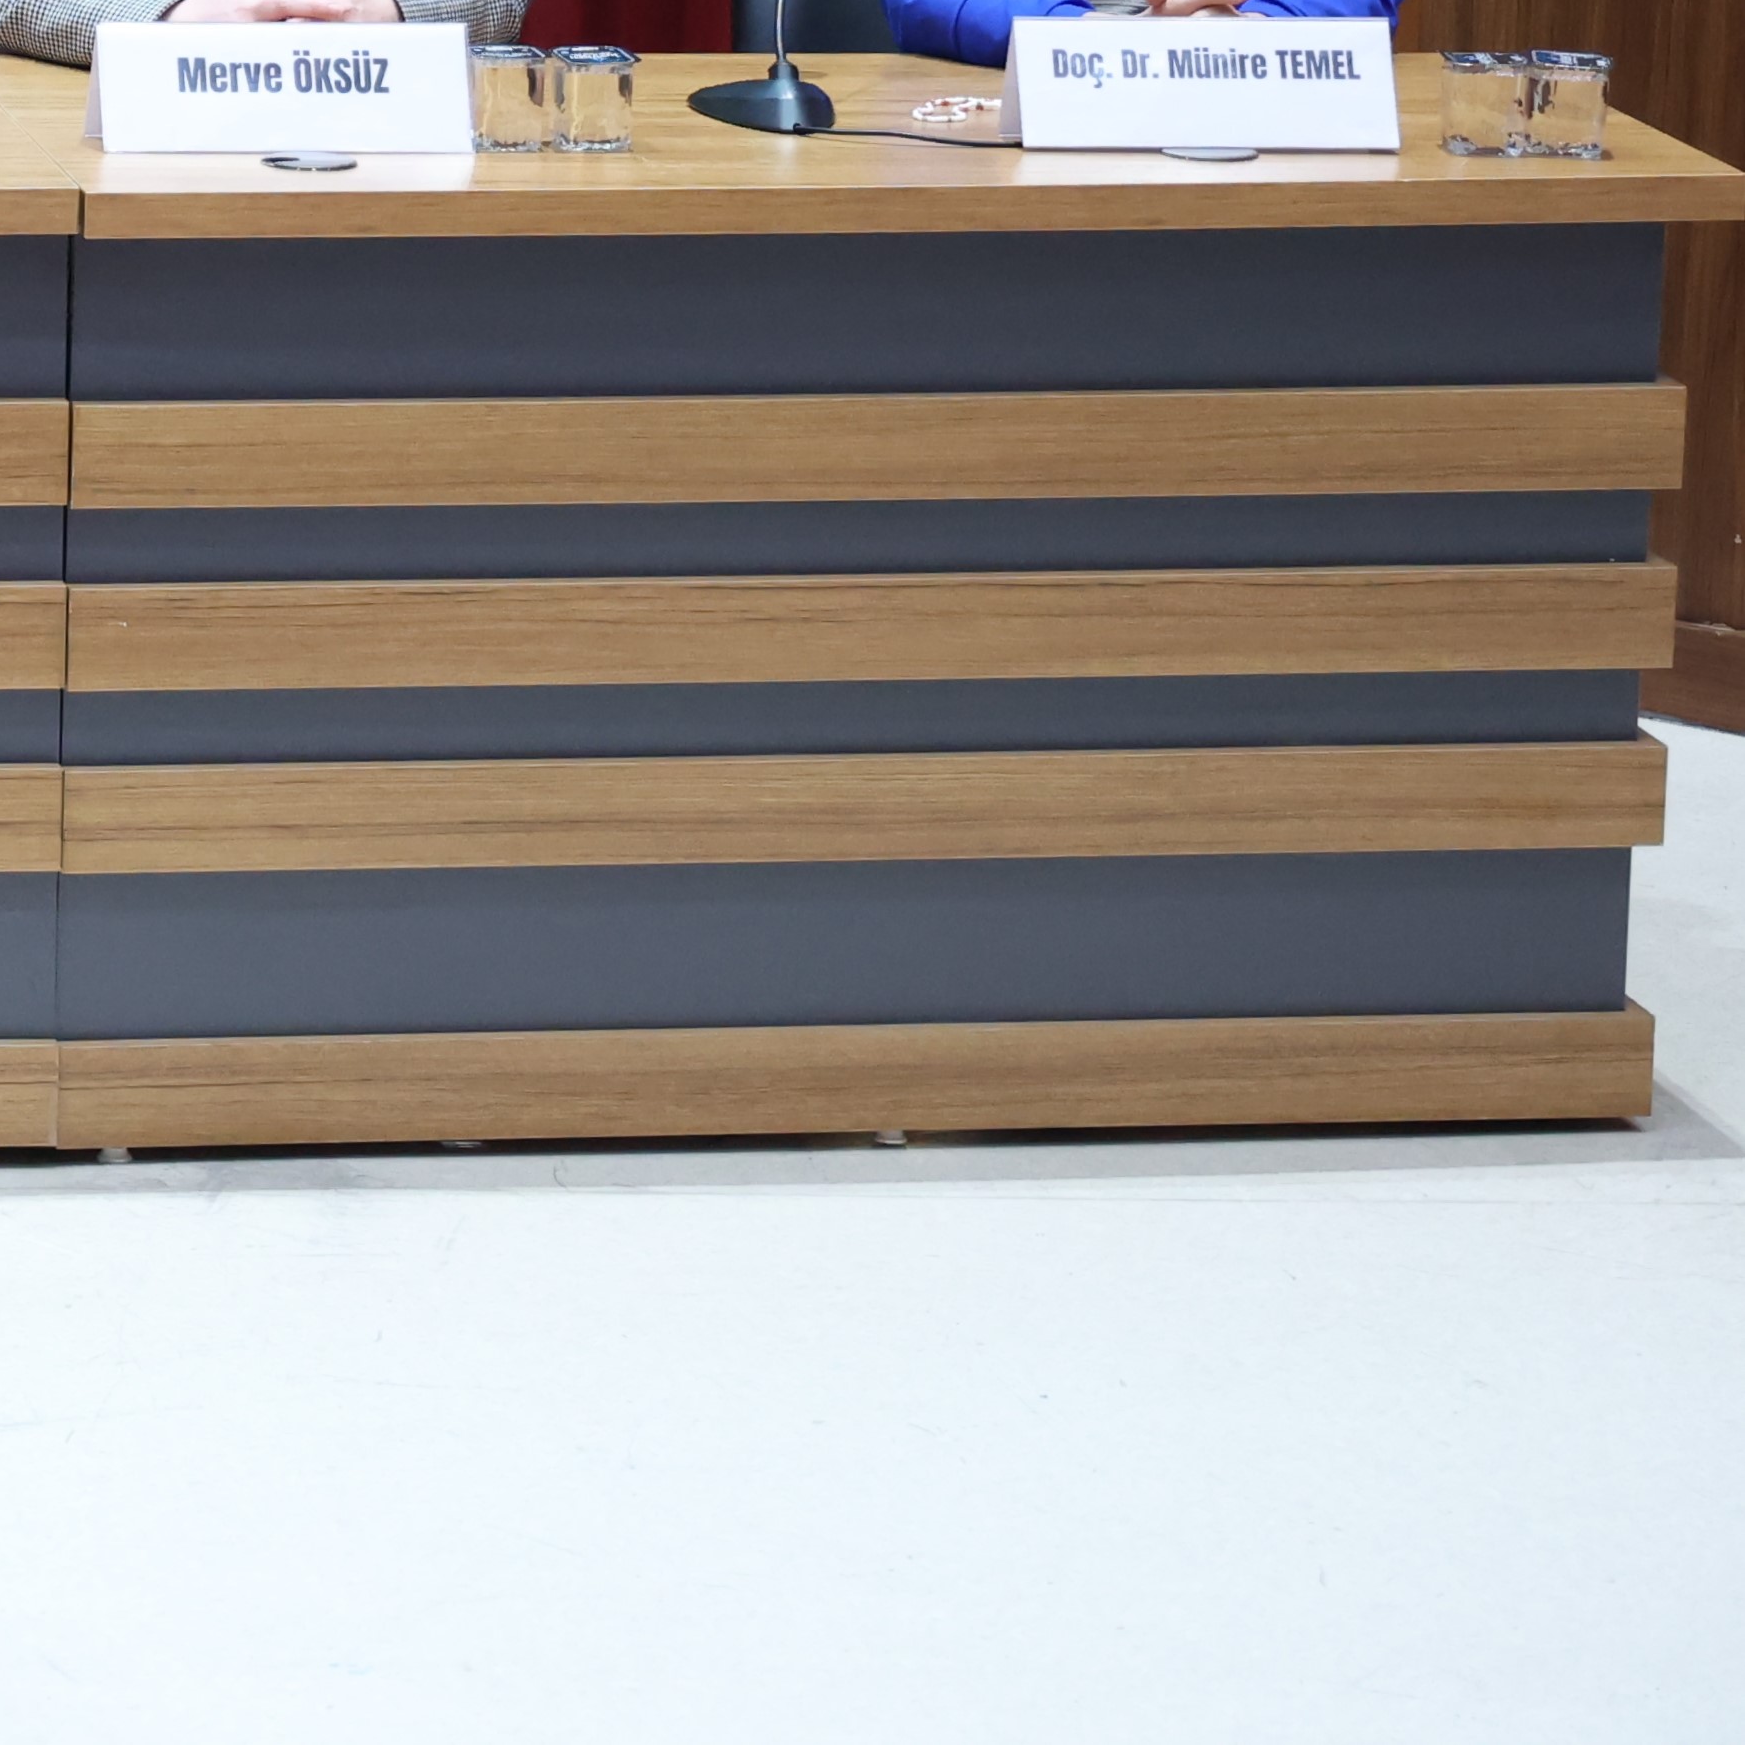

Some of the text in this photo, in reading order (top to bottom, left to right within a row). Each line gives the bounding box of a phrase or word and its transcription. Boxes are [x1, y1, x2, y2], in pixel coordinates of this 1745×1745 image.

[177, 50, 390, 94] Merve ÖKSÜZ
[1052, 47, 1361, 88] Doç. Dr. Münire TEMEL
